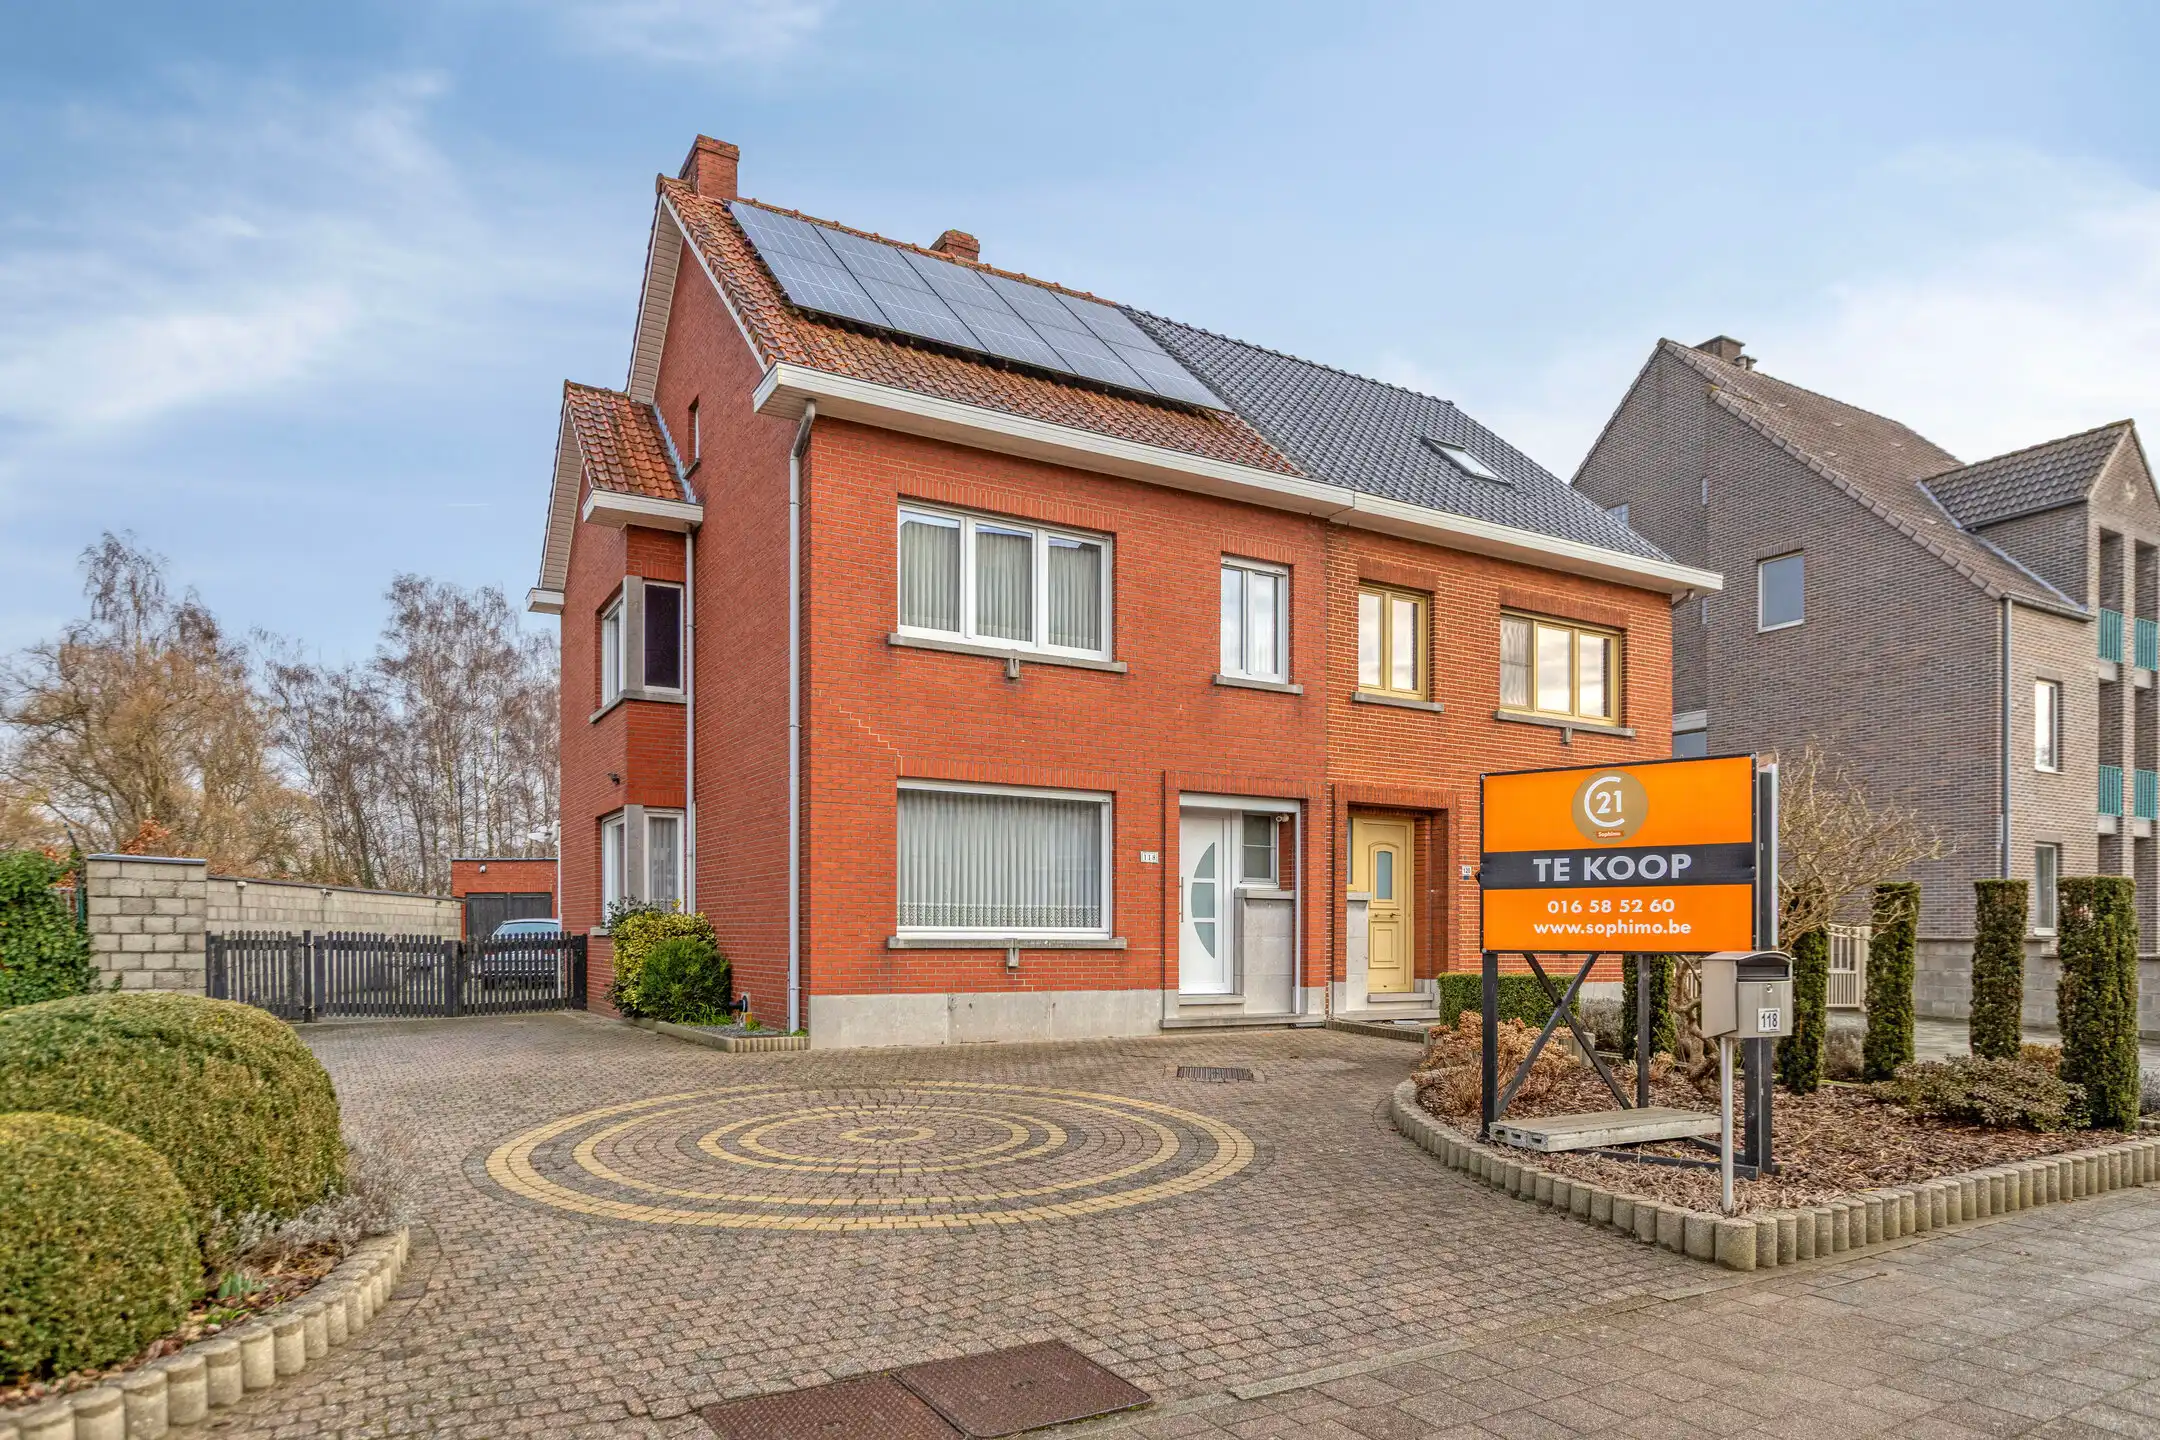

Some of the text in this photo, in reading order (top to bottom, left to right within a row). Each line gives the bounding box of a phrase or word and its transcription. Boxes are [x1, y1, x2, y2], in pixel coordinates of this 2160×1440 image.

[1533, 854, 1692, 882] TE KOOP
[1547, 898, 1675, 914] 016 58 52 60
[1533, 919, 1692, 937] www.sophimo.be
[1761, 1013, 1778, 1028] 118
